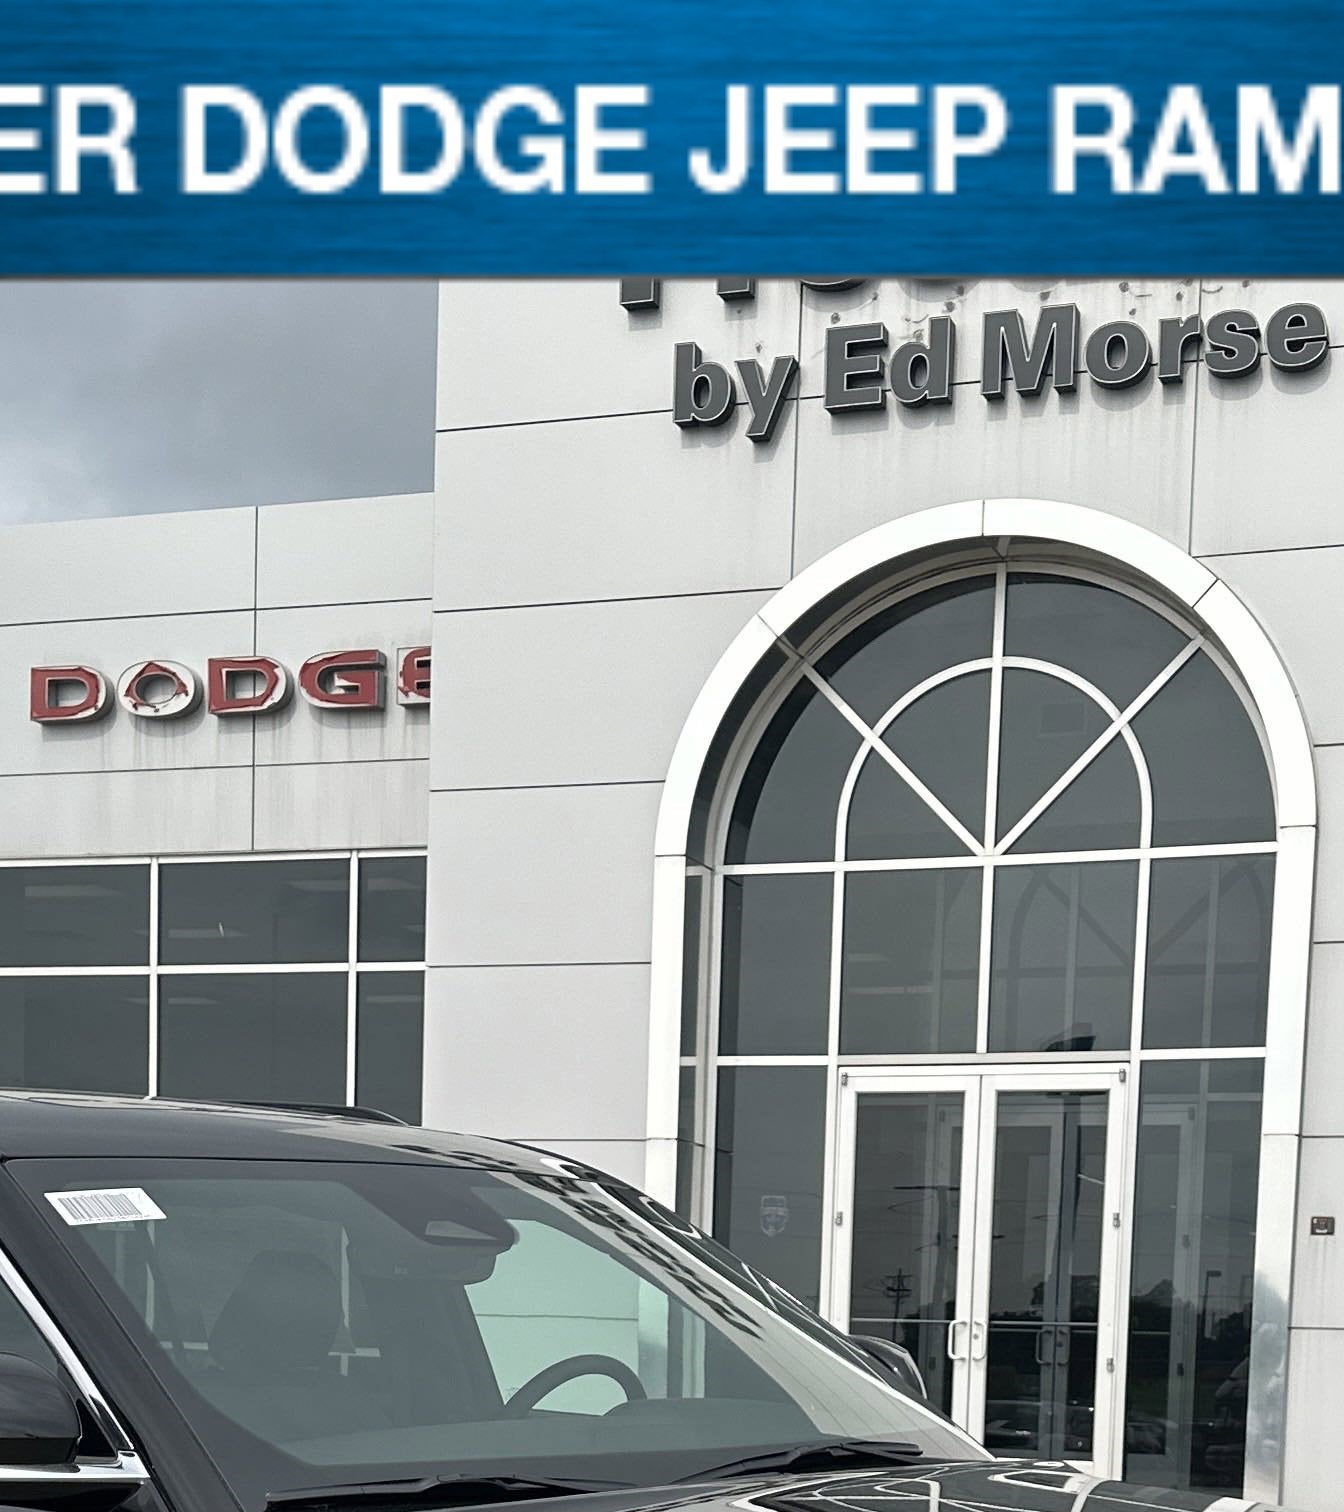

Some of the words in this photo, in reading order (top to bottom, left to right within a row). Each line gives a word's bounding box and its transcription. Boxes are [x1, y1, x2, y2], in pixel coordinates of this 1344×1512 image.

[672, 341, 798, 443] by
[824, 316, 956, 415] Ed
[981, 302, 1329, 402] Morse
